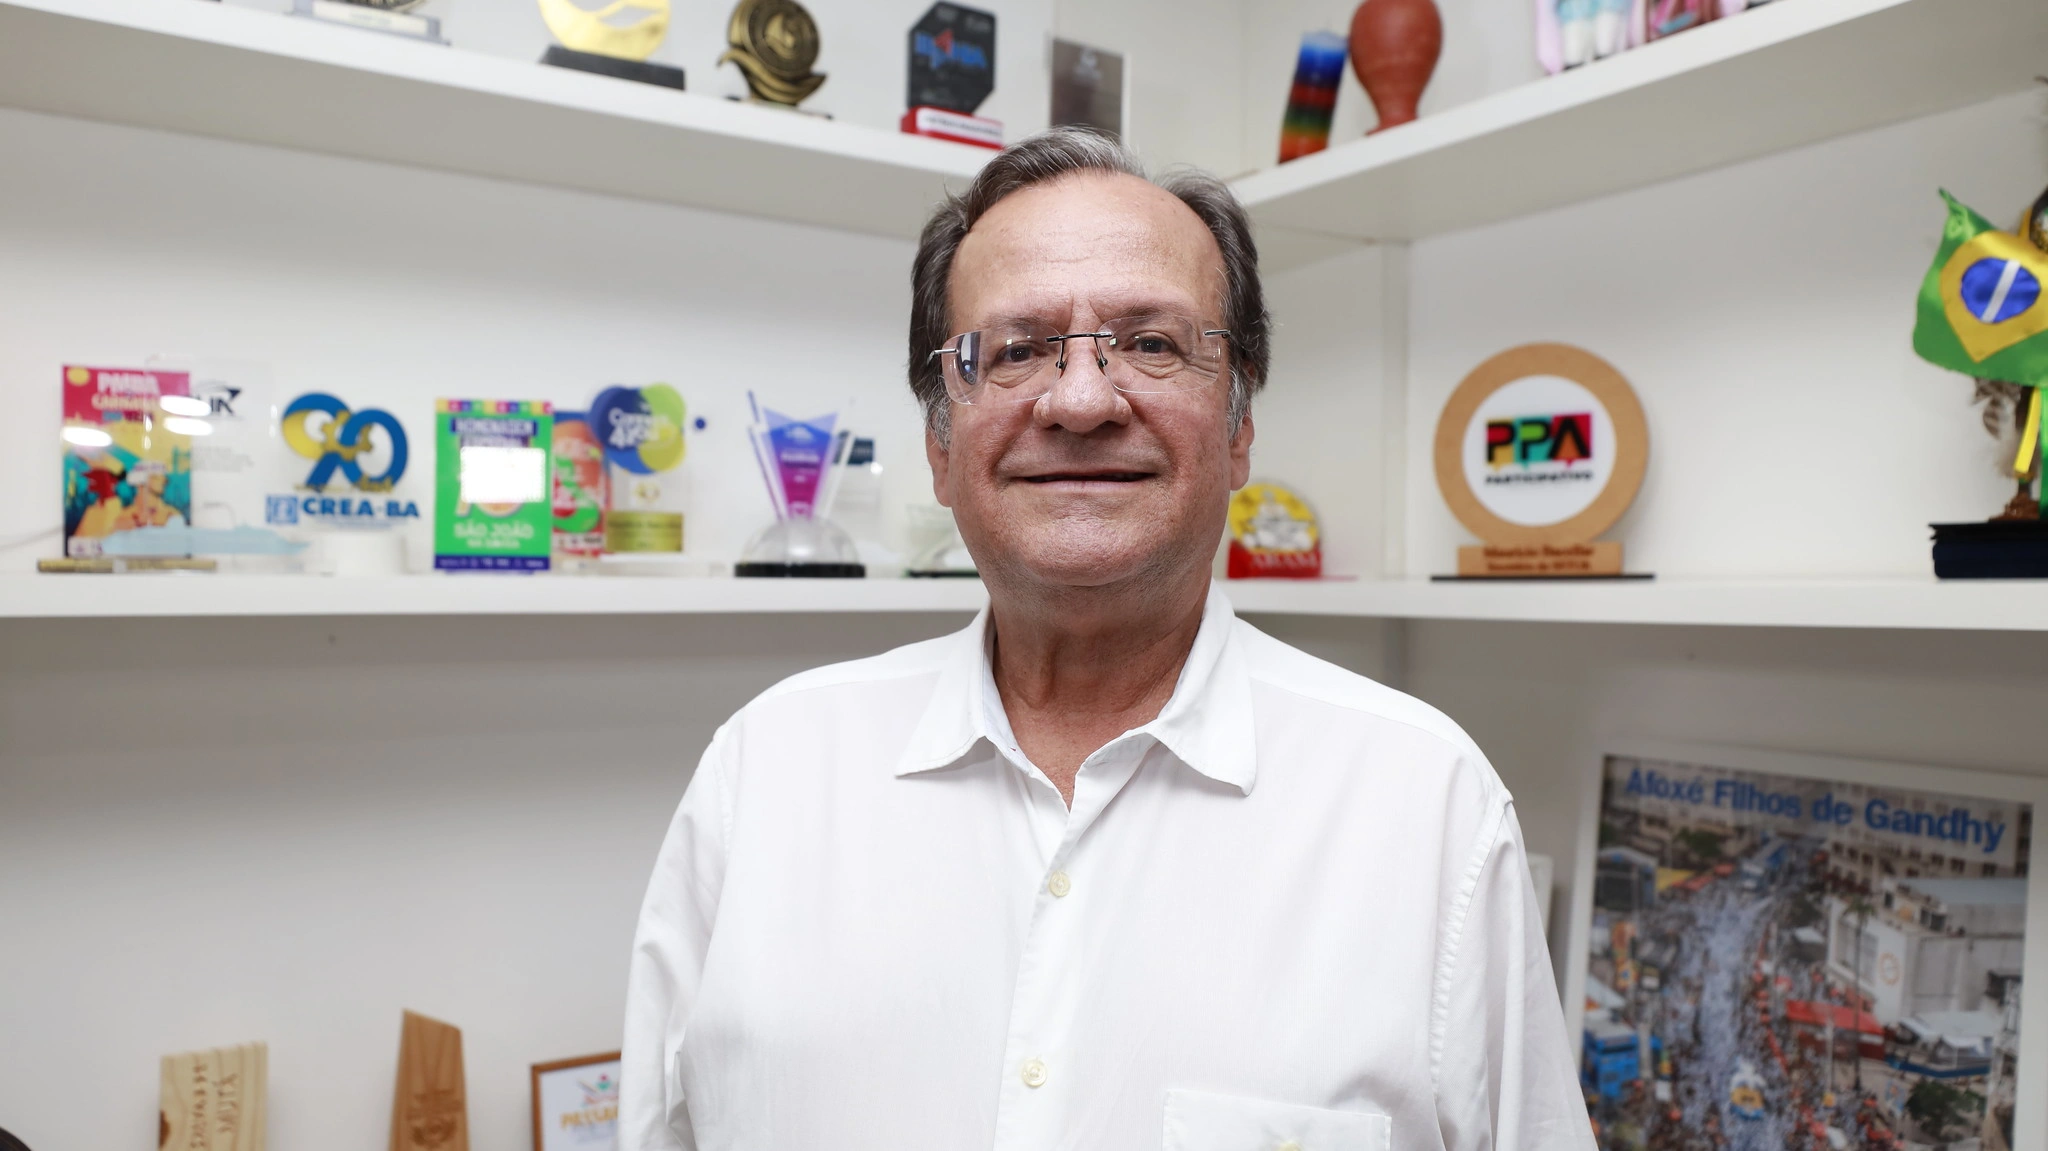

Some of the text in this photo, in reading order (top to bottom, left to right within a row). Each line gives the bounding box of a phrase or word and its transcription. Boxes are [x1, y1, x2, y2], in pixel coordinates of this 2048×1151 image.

[1486, 416, 1591, 462] PPA
[303, 497, 419, 518] CREA-BA
[454, 519, 535, 541] SÃO JOÃO
[1626, 767, 2006, 854] Afoxé Filhos de Gandhy
